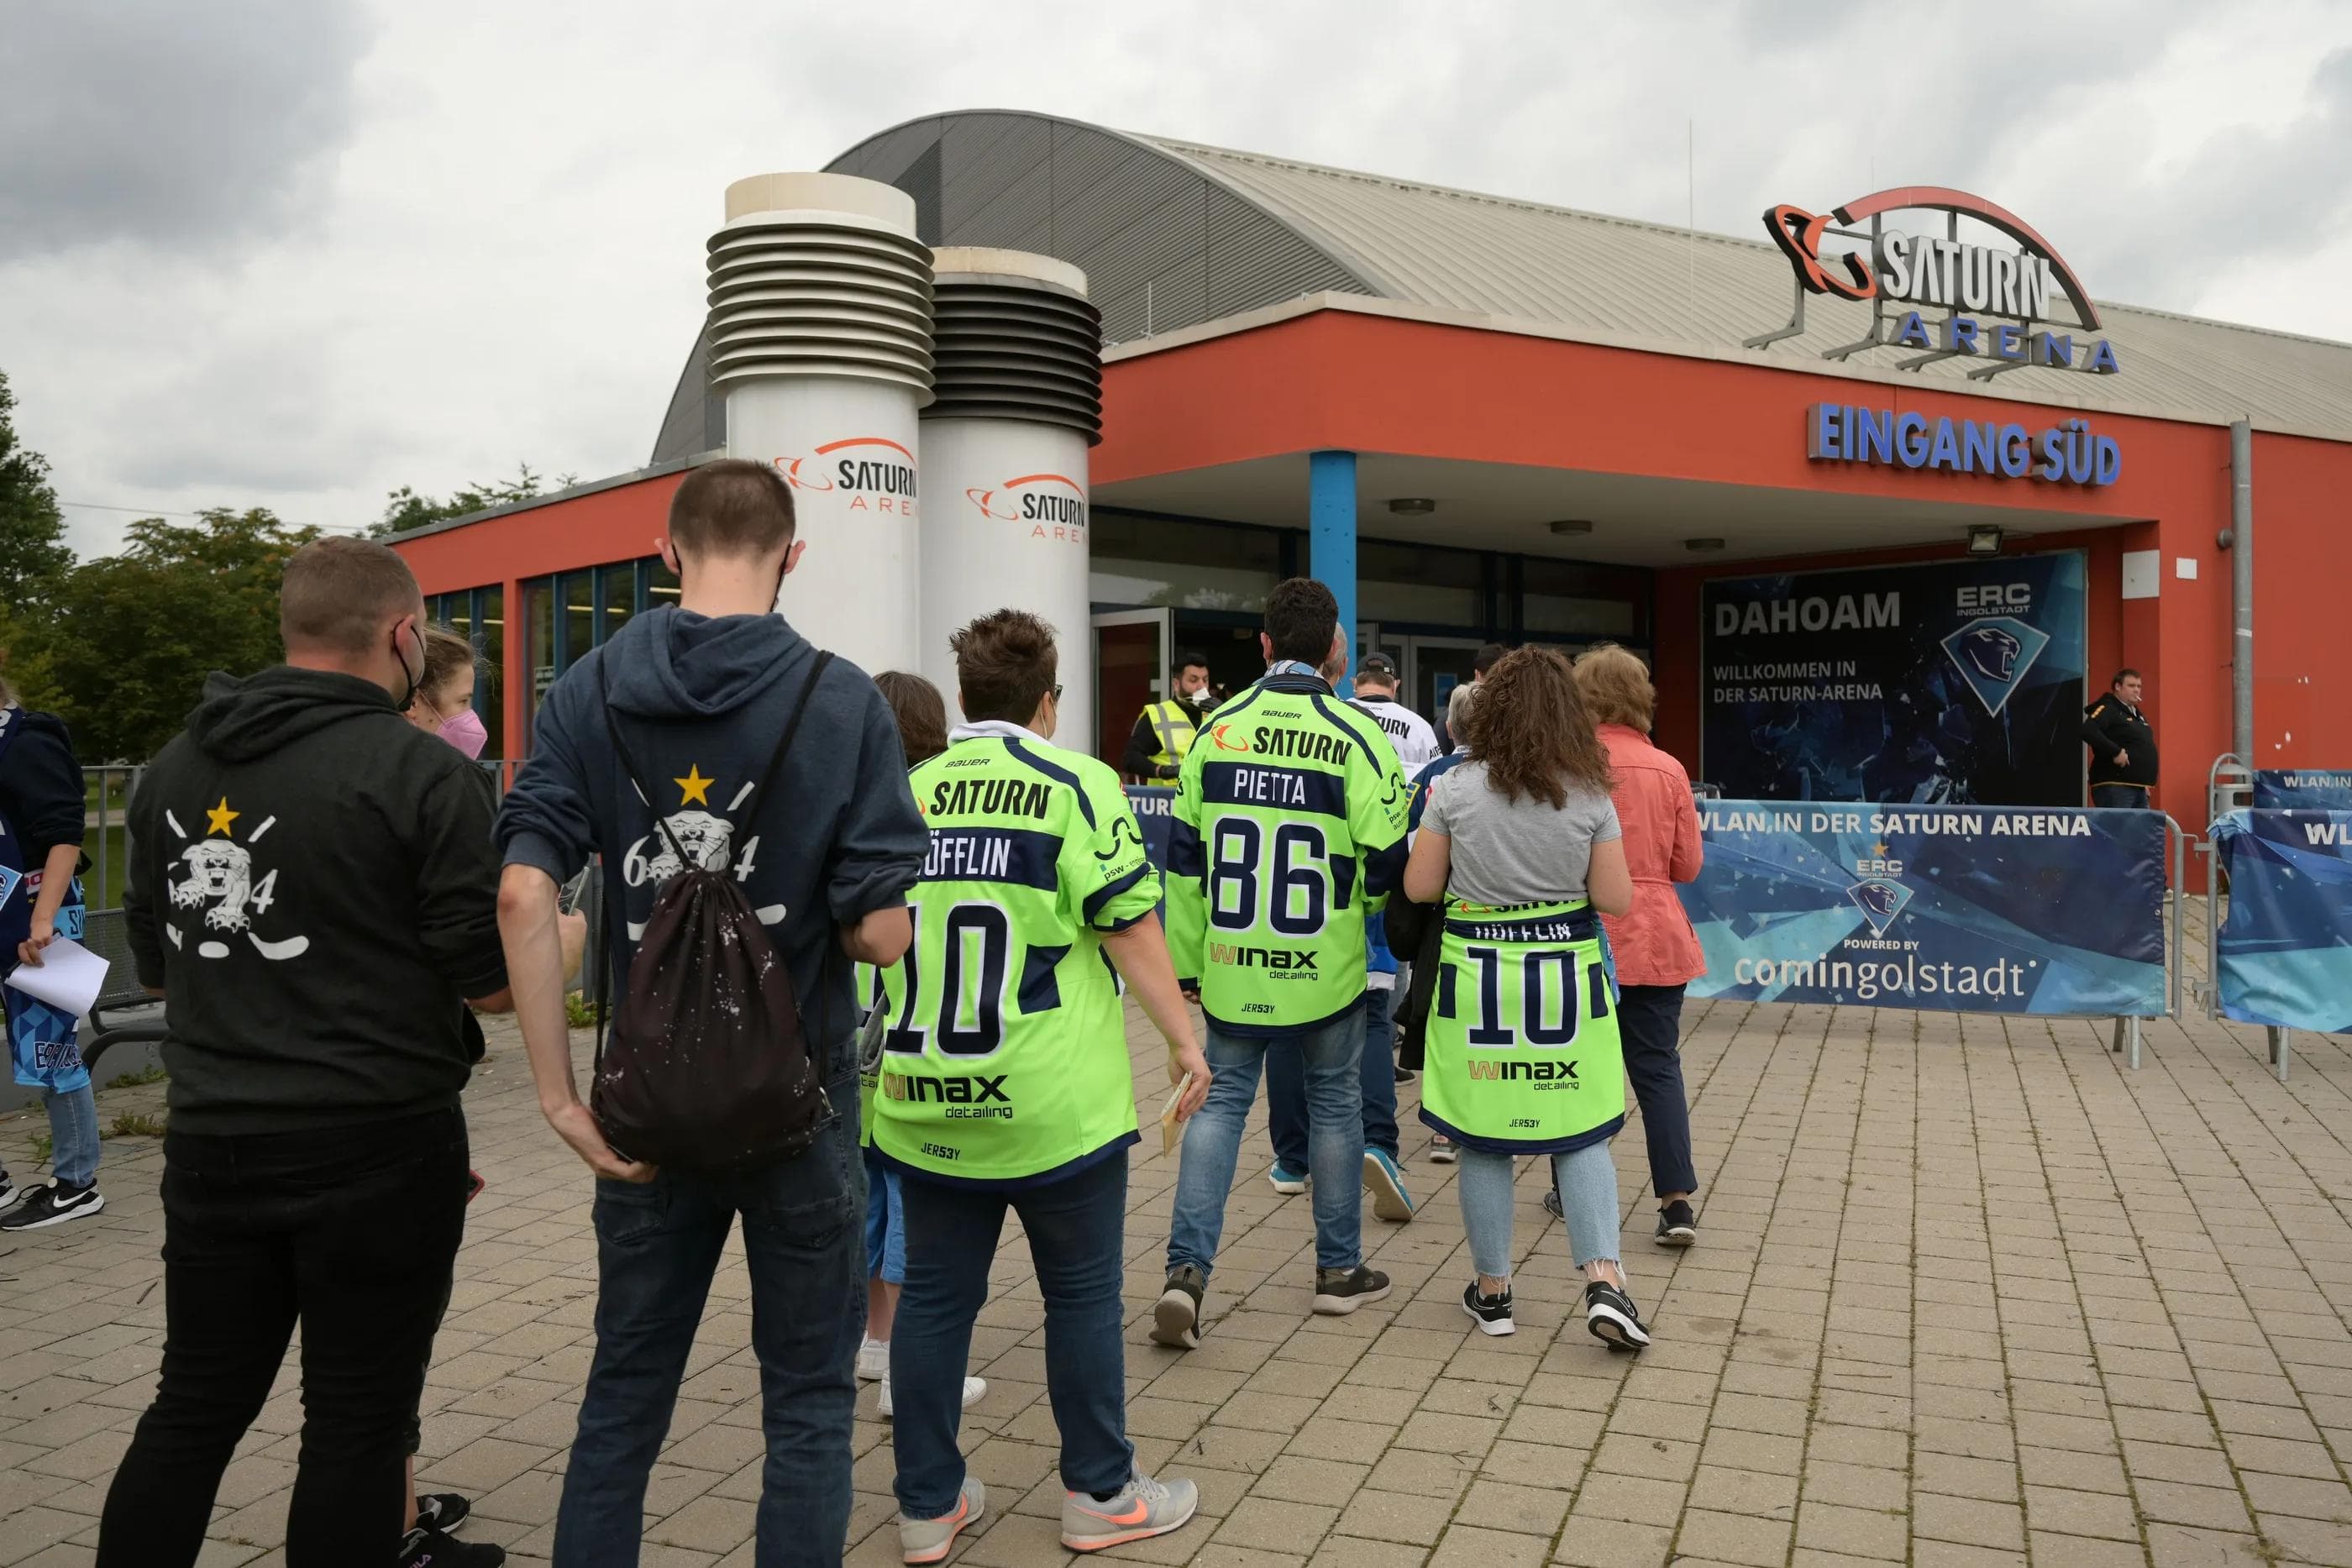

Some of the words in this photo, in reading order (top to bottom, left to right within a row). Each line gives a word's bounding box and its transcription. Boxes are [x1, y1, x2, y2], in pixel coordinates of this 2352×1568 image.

[1882, 229, 2050, 321] SATURN
[1898, 311, 2120, 374] ARENA
[1816, 402, 2031, 479] EINGANG
[2038, 417, 2122, 486] SÜD
[838, 459, 917, 498] SATURN
[849, 495, 920, 518] ARE
[1022, 492, 1085, 527] SATURN
[1956, 582, 2031, 608] ERC
[1956, 605, 2031, 617] INGOLSTADT
[1715, 590, 1901, 637] DAHOAM
[1713, 661, 1832, 681] WILLKOMMEN
[1836, 659, 1856, 677] IN
[1714, 687, 1746, 705] DER
[1749, 683, 1884, 704] SATURN-ARENA
[1252, 726, 1352, 767] SATURN
[1232, 768, 1306, 805] PIETTA
[2283, 775, 2330, 788] WLAN
[929, 779, 1053, 821] SATURN
[1775, 811, 1803, 833] IN
[1811, 812, 1862, 834] DER
[1869, 813, 1982, 836] SATURN
[1990, 814, 2092, 836] ARENA
[916, 829, 1011, 878] ÖFFLIN
[1856, 859, 1903, 872] ERC
[1209, 814, 1329, 940] 86
[1843, 939, 1901, 951] POWERED
[1903, 939, 1920, 952] BY
[884, 900, 1012, 1059] 10
[1269, 970, 1319, 981] detailing
[1466, 945, 1578, 1049] 10
[1533, 1080, 1579, 1091] detailing
[945, 1105, 1013, 1120] detailing
